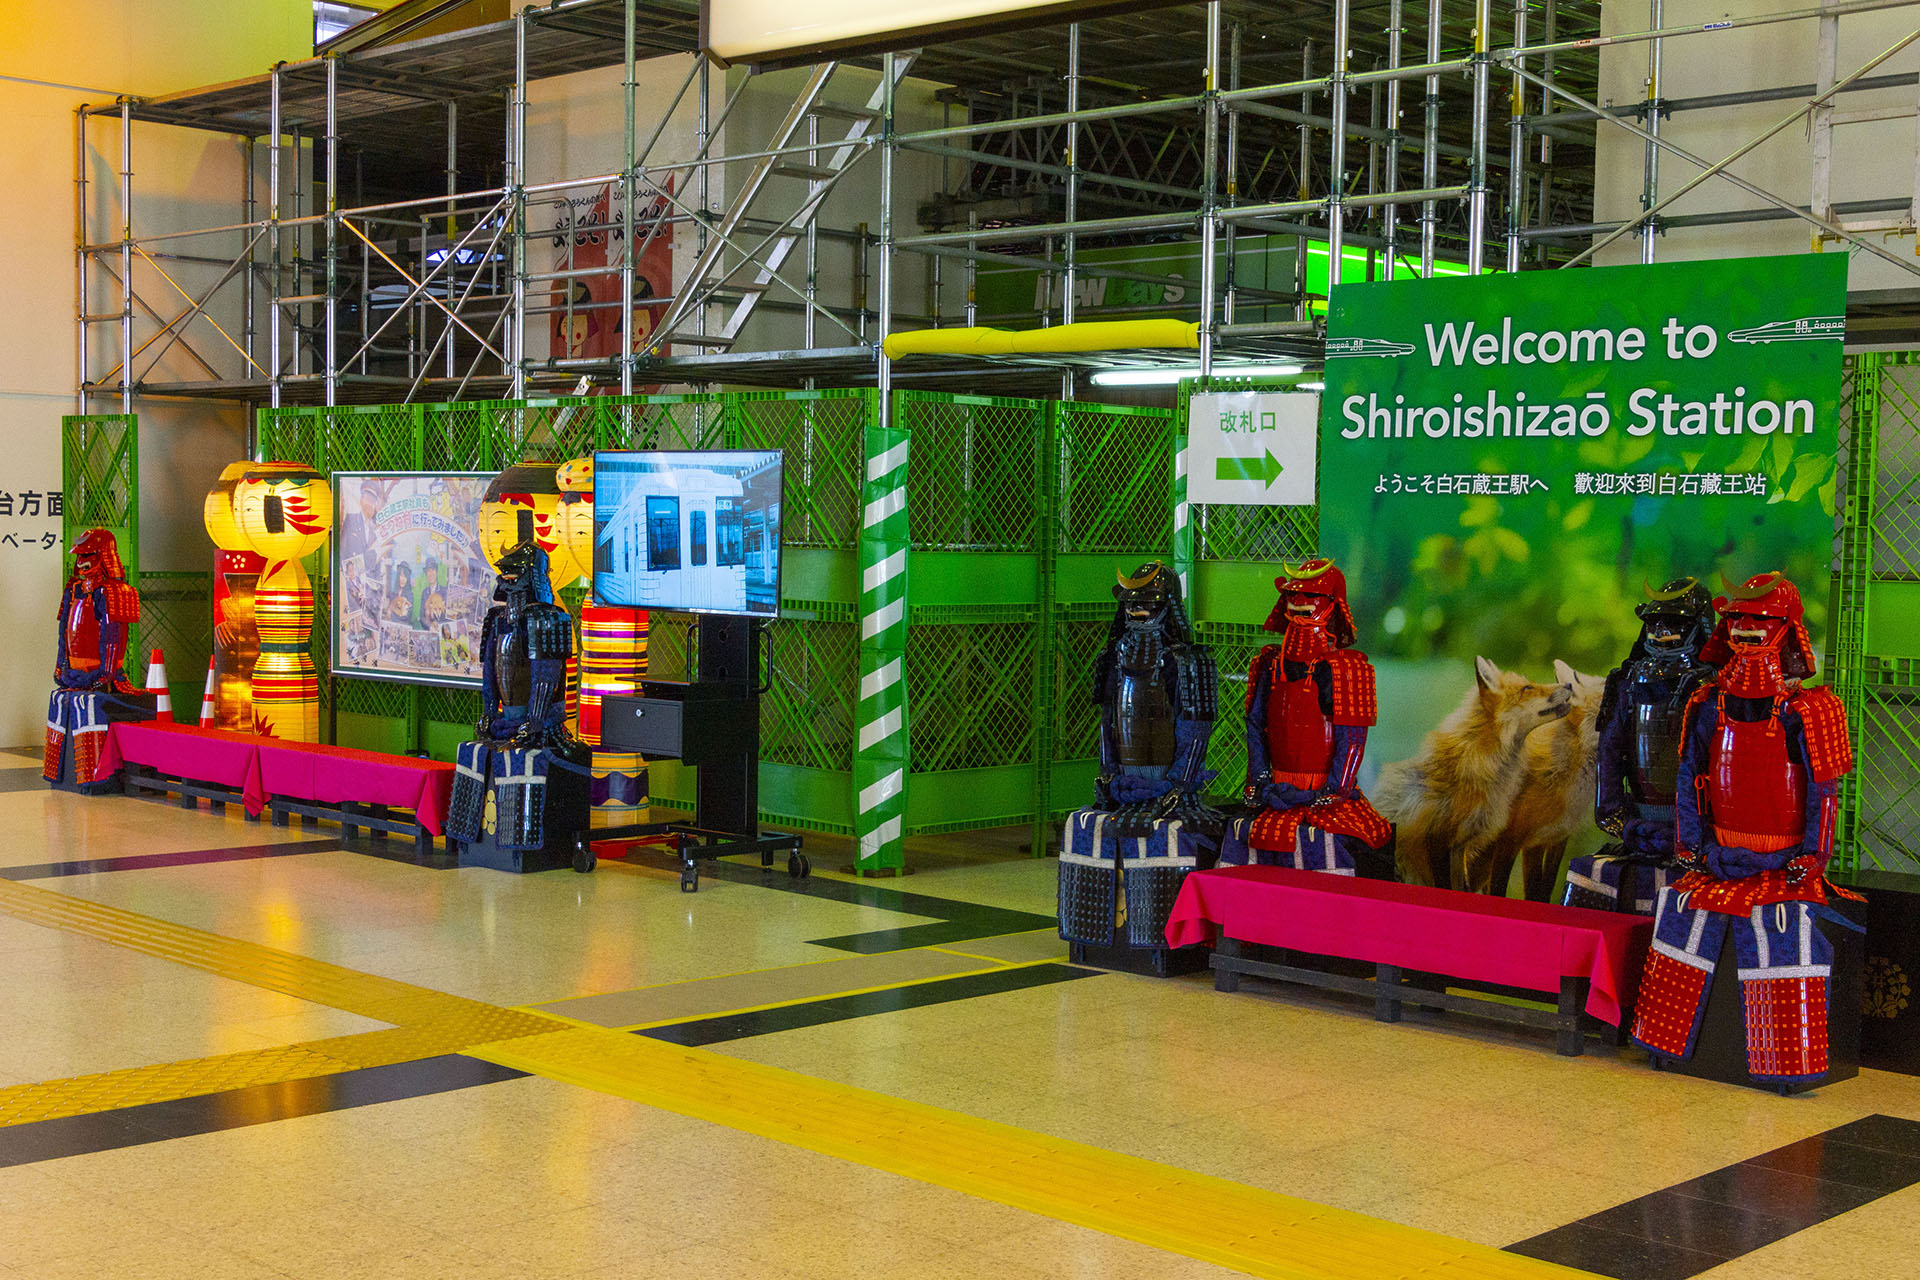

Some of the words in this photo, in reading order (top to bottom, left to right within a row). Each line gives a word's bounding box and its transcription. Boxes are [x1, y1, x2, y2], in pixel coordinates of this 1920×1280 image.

[1424, 316, 1646, 367] Welcome
[1662, 318, 1718, 360] to
[1219, 410, 1276, 433] 改札口
[1340, 389, 1610, 440] Shiroishizaō
[1626, 386, 1815, 437] Station
[1374, 473, 1549, 495] ようこそ白石蔵王駅へ
[1574, 472, 1767, 496] 歡迎來到白石藏王站
[2, 532, 63, 550] ベータ
